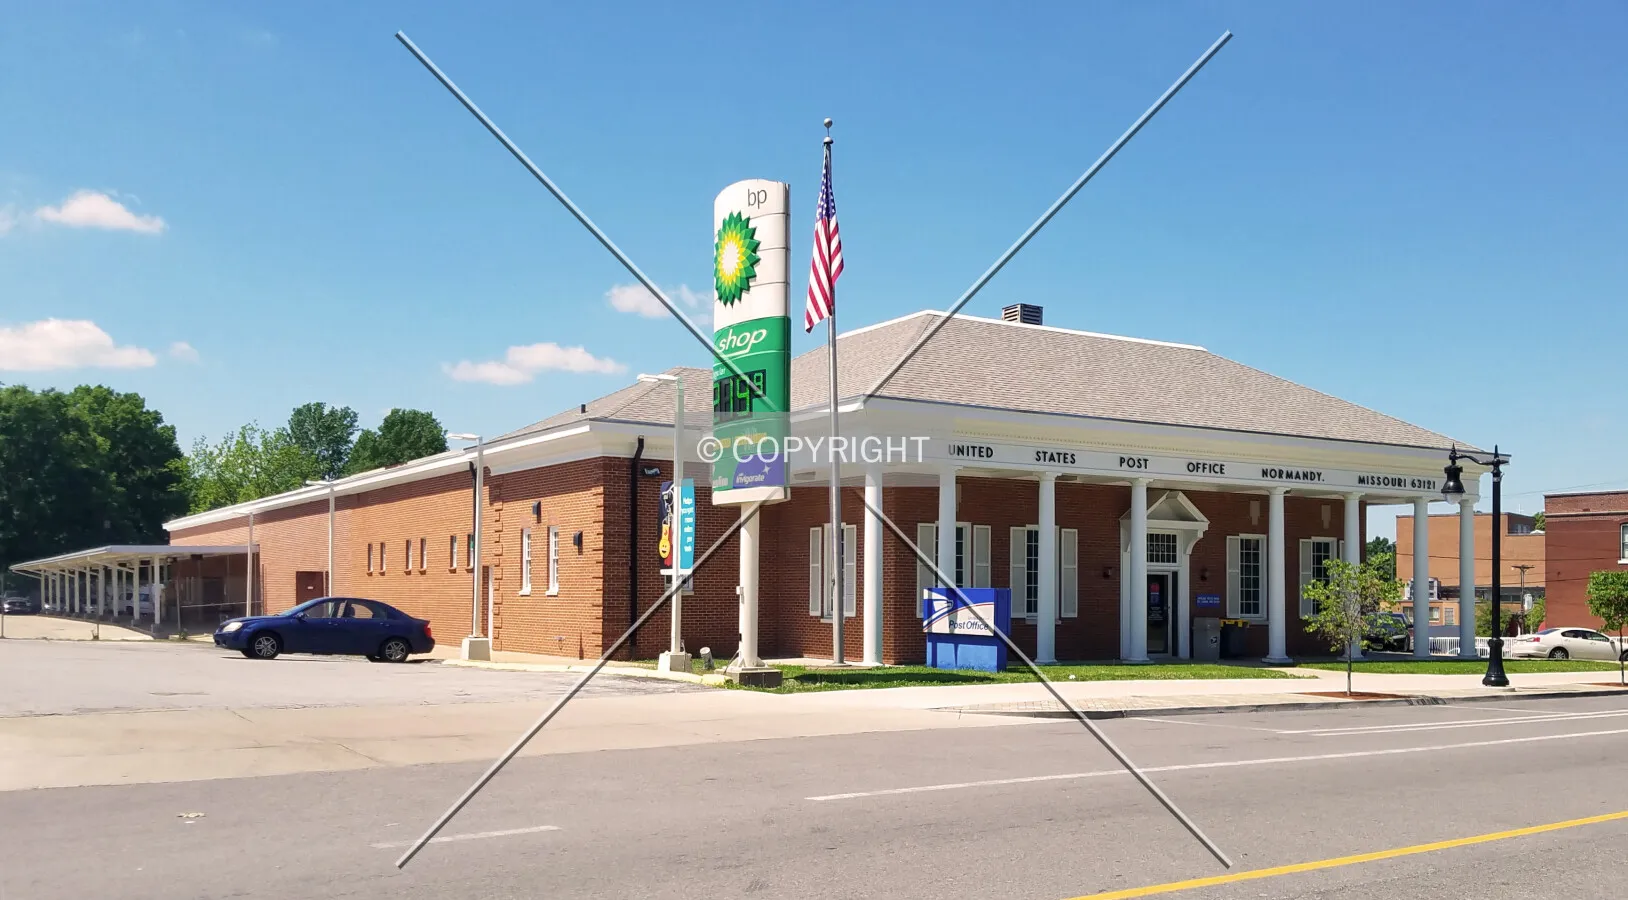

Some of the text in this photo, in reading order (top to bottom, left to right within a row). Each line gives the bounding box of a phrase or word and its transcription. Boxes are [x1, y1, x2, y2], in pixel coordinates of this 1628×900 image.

[747, 188, 767, 209] bp
[719, 328, 767, 354] shop
[948, 444, 994, 458] UNITED
[1035, 450, 1076, 464] STATES
[1119, 456, 1149, 470] POST
[1186, 462, 1225, 475] OFFICE
[1358, 475, 1407, 488] MISSOURI
[1411, 478, 1436, 490] 63121
[949, 620, 989, 631] Post Office
